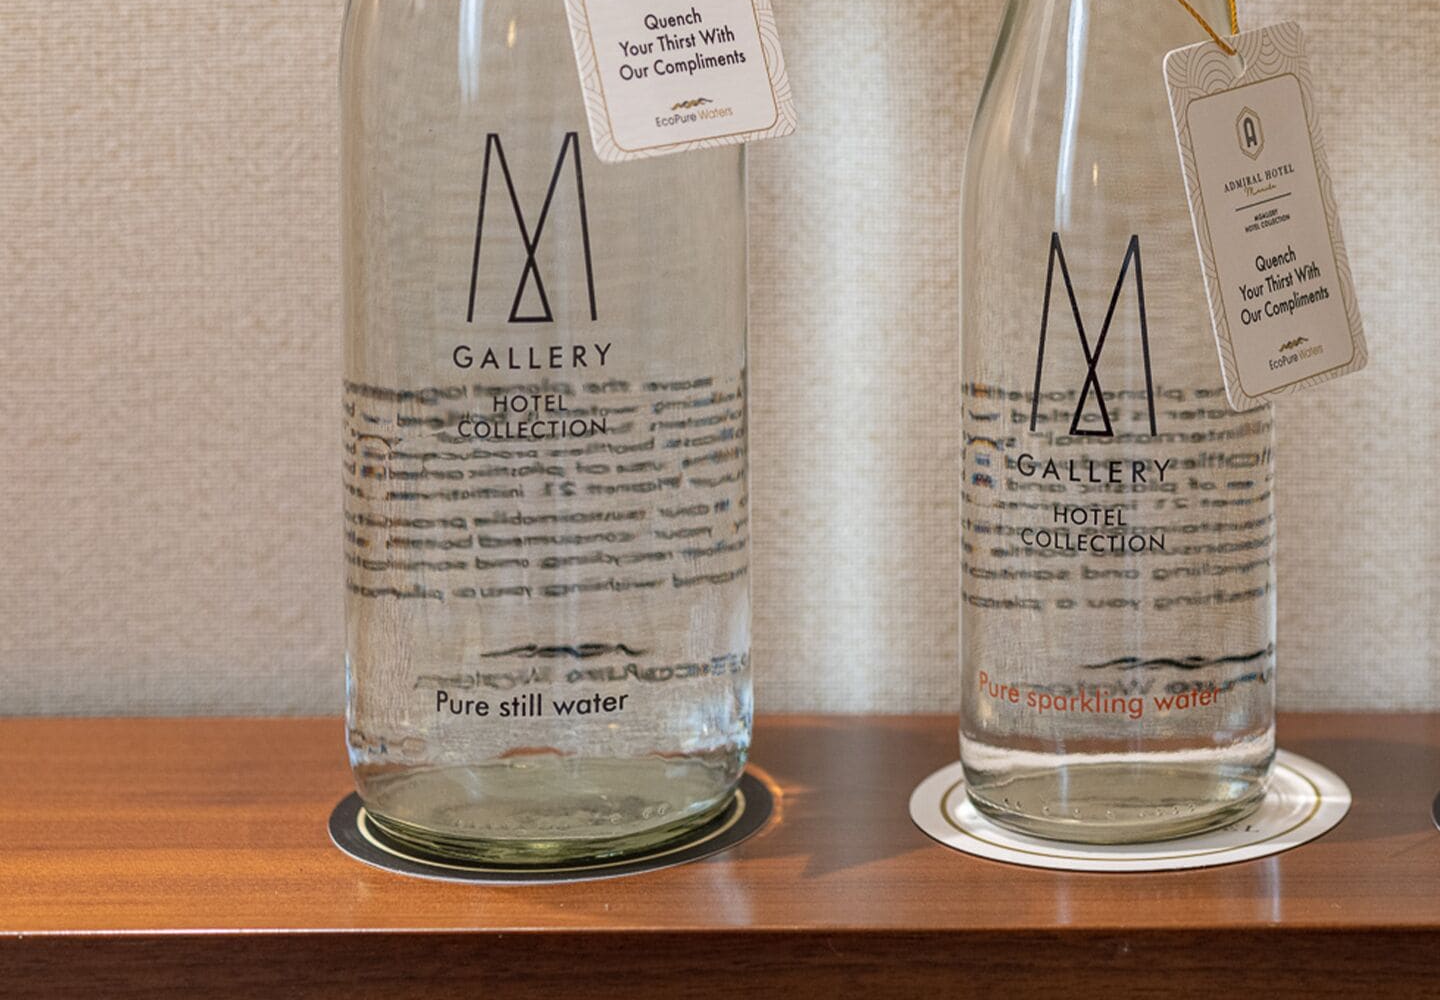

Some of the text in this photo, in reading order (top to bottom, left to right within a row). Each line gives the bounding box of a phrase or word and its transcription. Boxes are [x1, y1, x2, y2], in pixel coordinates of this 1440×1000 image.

[644, 7, 702, 29] Quench
[619, 25, 735, 56] Your Thirst With
[619, 50, 746, 80] Our Compliments
[655, 107, 733, 127] EcoPure Waters
[1224, 164, 1295, 193] ADMIRAL HOTEL
[1255, 245, 1296, 272] Quench
[1239, 261, 1321, 301] Your Thirst With
[1240, 286, 1330, 325] Our Compliments
[453, 343, 611, 369] GALLERY
[493, 394, 569, 413] HOTEL
[457, 418, 607, 439] COLLECTION
[1017, 454, 1170, 482] GALLERY
[1054, 506, 1127, 526] HOTEL
[1021, 528, 1165, 552] COLLECTION
[436, 691, 629, 717] Pure still water
[979, 671, 1020, 703] Pure
[1027, 687, 1144, 719] sparkling
[1154, 687, 1222, 711] water
